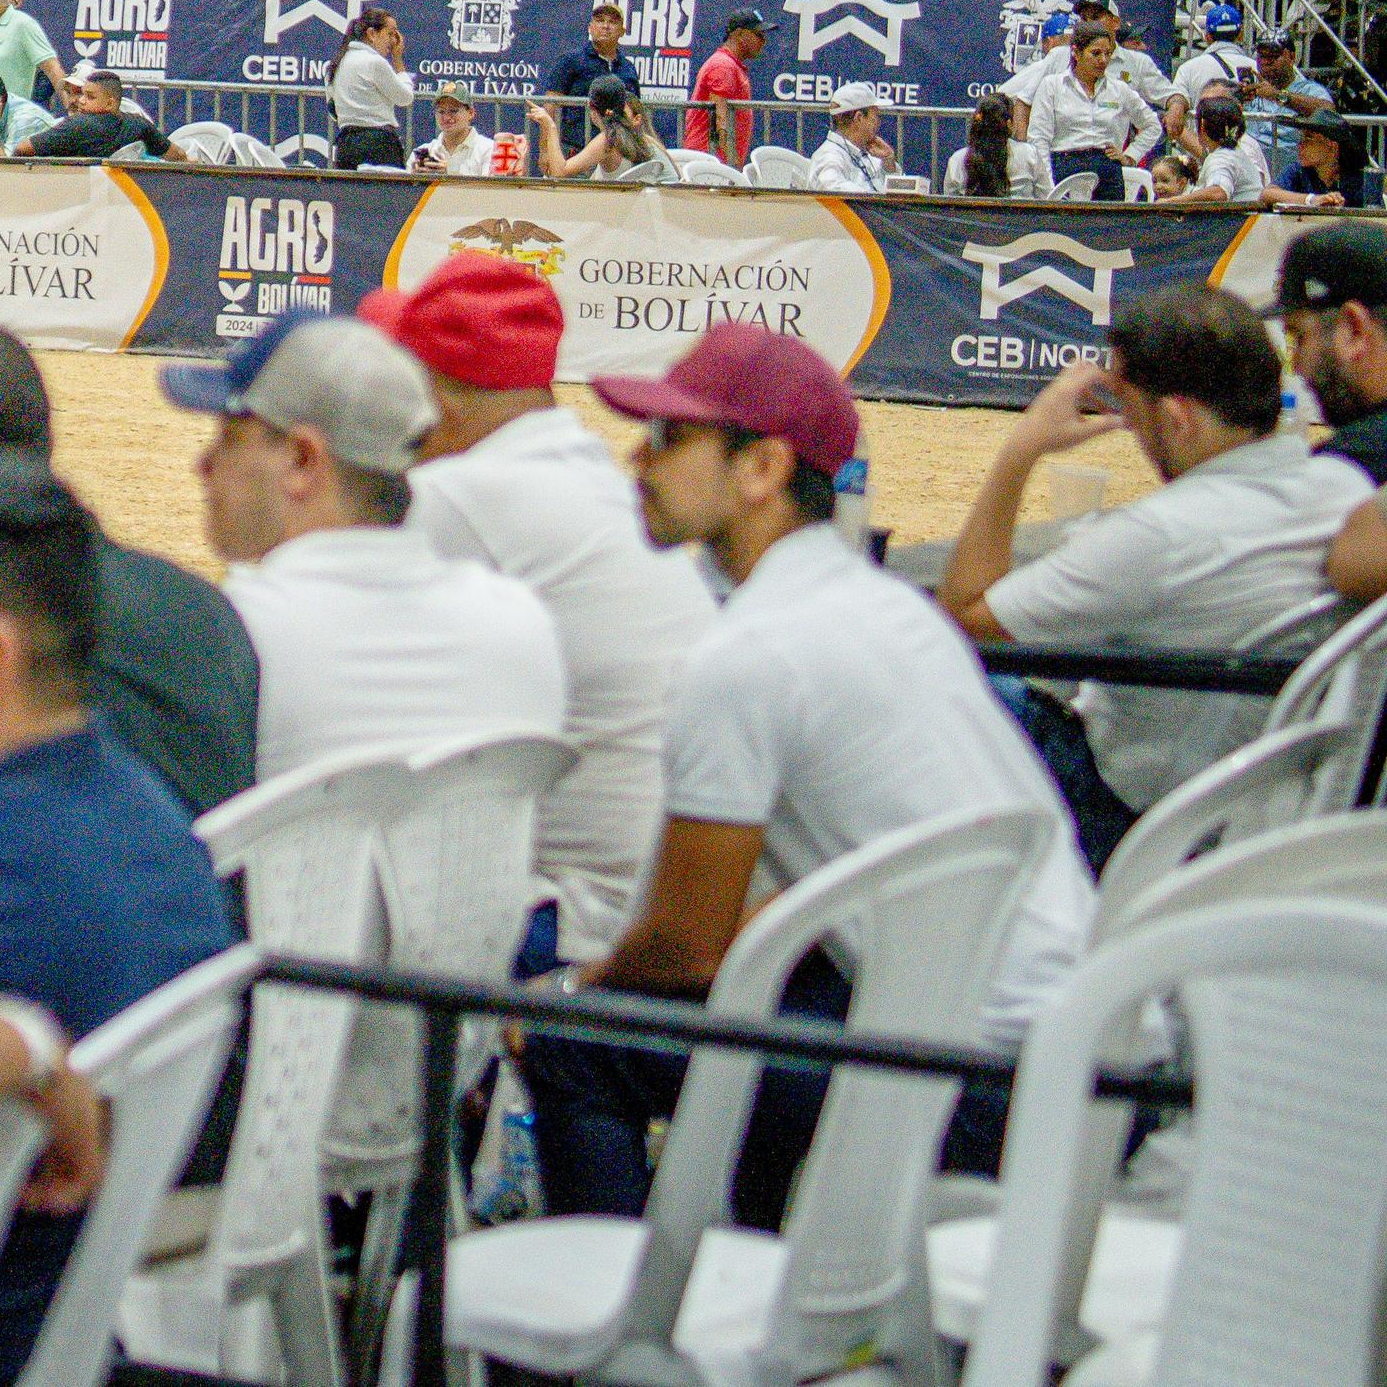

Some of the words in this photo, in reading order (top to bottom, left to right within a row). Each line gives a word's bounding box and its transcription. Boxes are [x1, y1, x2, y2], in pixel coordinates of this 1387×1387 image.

[106, 32, 167, 69] BOLÍVAR
[242, 55, 299, 81] CEB
[624, 49, 690, 87] OLÍVAR
[418, 59, 539, 79] GOBERNACIÓN
[773, 72, 832, 102] CEB
[849, 81, 920, 105] ORTE
[220, 196, 334, 274] AGRO
[579, 259, 811, 293] GOBERNACIÓN
[257, 276, 331, 314] BOLÍVAR
[225, 319, 253, 331] 2024
[579, 301, 605, 319] DE
[614, 293, 806, 337] BOLÍVAR
[950, 334, 1025, 368] CEB
[1039, 342, 1112, 370] NORT
